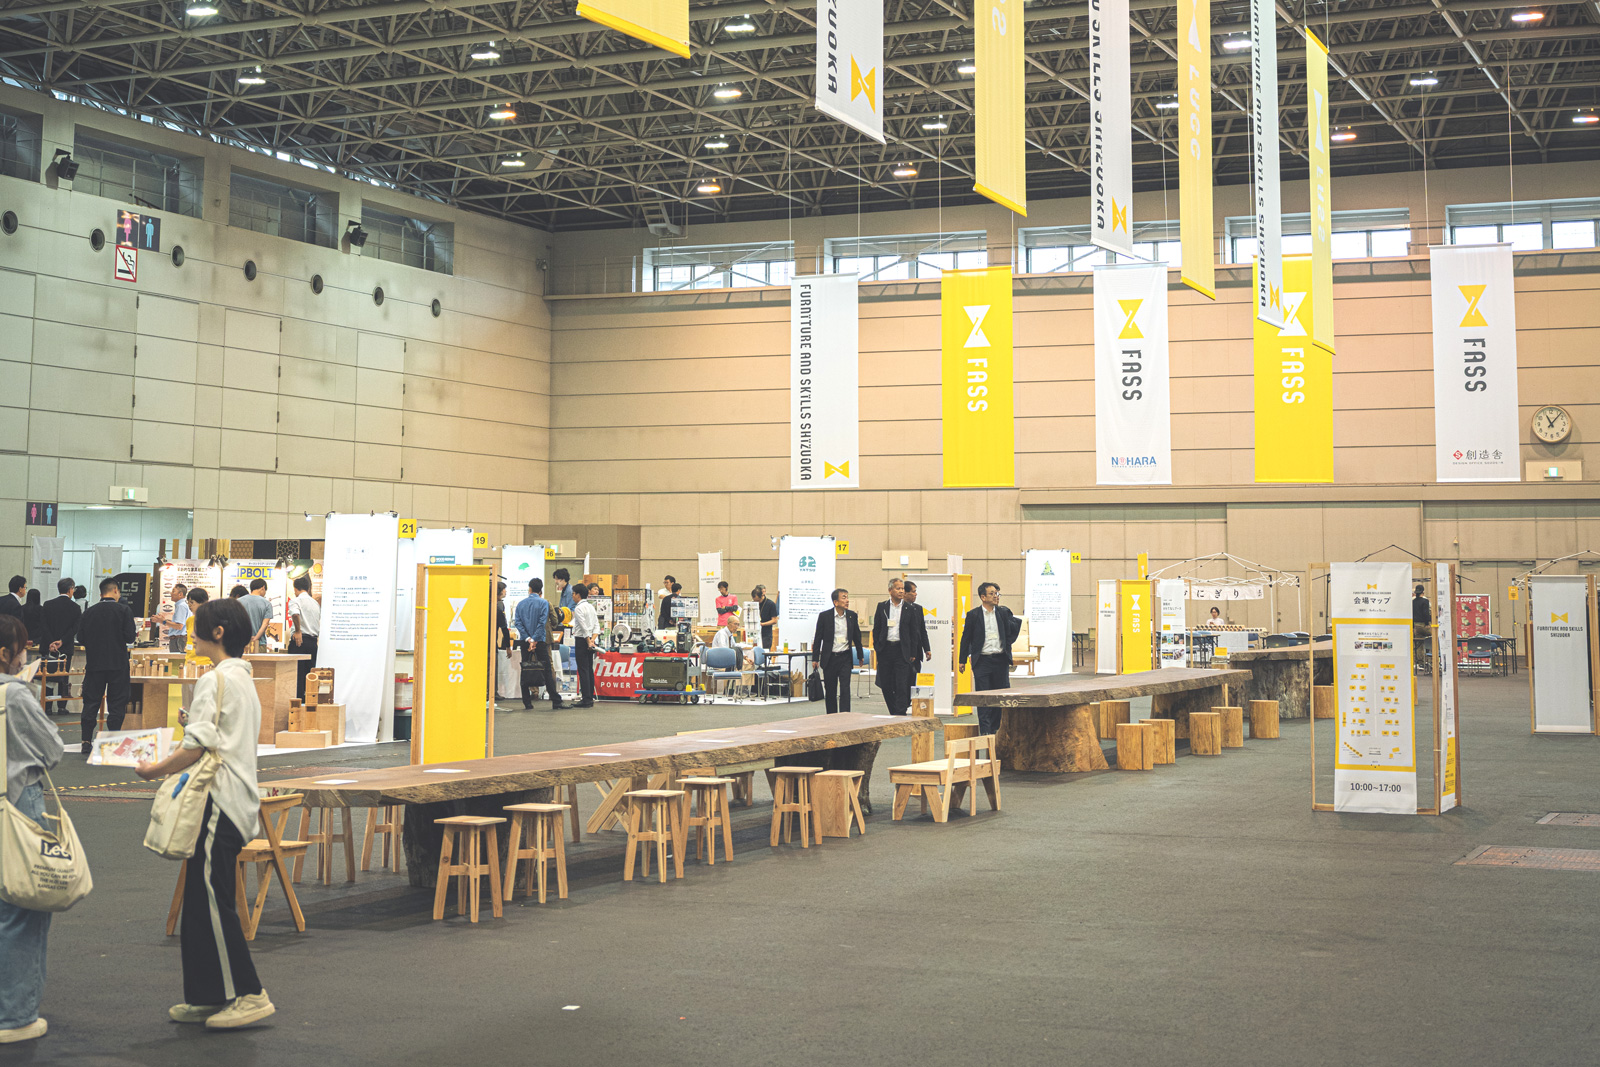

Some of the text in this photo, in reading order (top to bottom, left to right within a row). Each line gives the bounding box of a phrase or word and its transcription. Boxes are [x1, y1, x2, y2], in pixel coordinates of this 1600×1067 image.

[800, 352, 811, 375] AND
[1122, 350, 1142, 400] FASS
[1281, 347, 1305, 403] FASS
[1463, 338, 1487, 392] FASS
[800, 378, 811, 419] SKILLS
[967, 358, 988, 412] FASS
[1111, 456, 1157, 465] NOHARA
[1466, 449, 1502, 460] 創造舎
[402, 523, 414, 533] 21
[475, 536, 485, 544] 19
[1132, 613, 1140, 633] FASS
[448, 640, 464, 683] FASS
